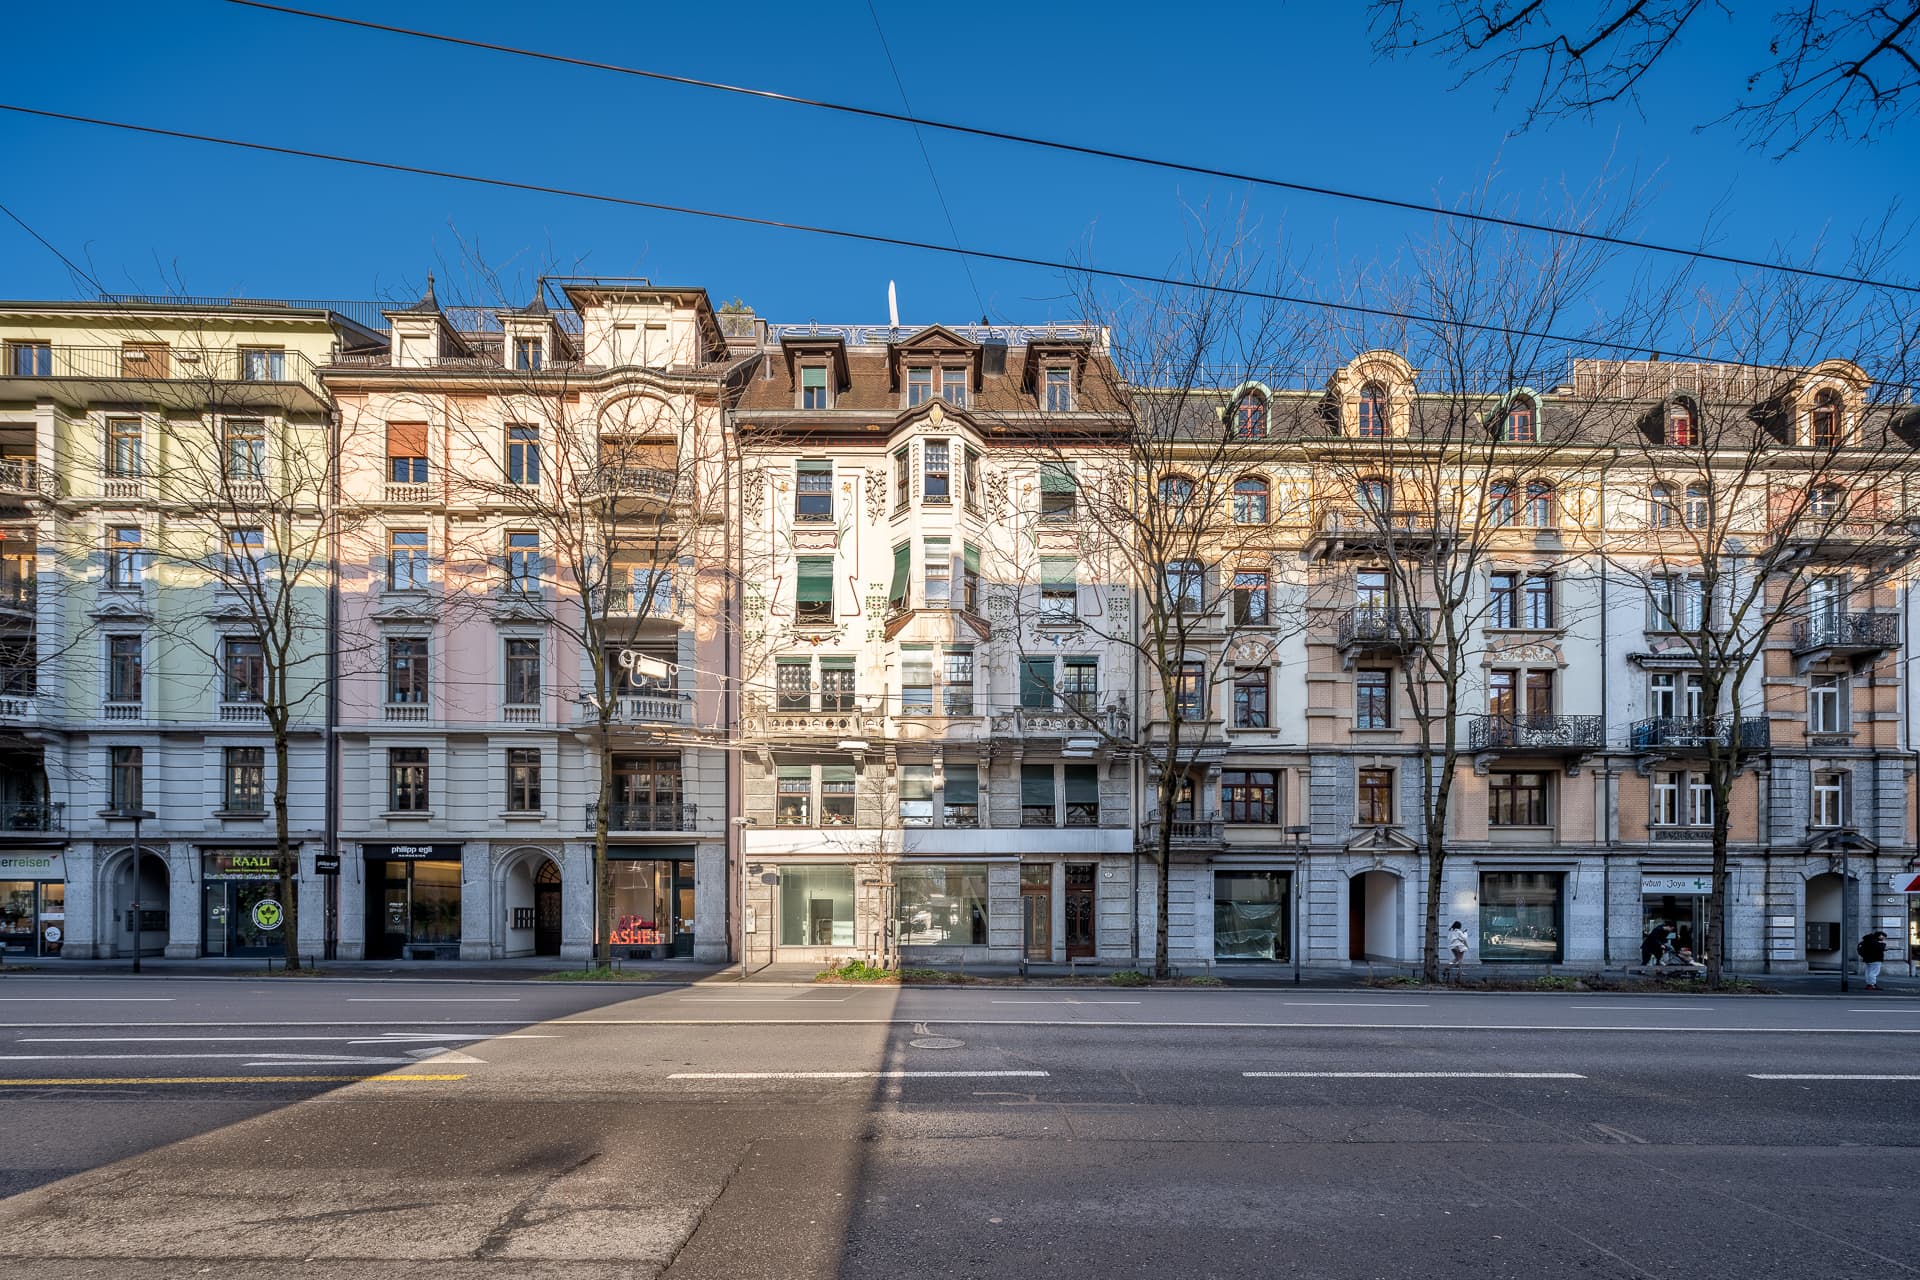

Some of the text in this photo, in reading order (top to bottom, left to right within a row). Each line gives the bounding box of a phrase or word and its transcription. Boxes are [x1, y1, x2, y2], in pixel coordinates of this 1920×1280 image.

[391, 845, 433, 854] philipp egli
[0, 856, 50, 867] erreisen
[232, 856, 270, 867] RAALI
